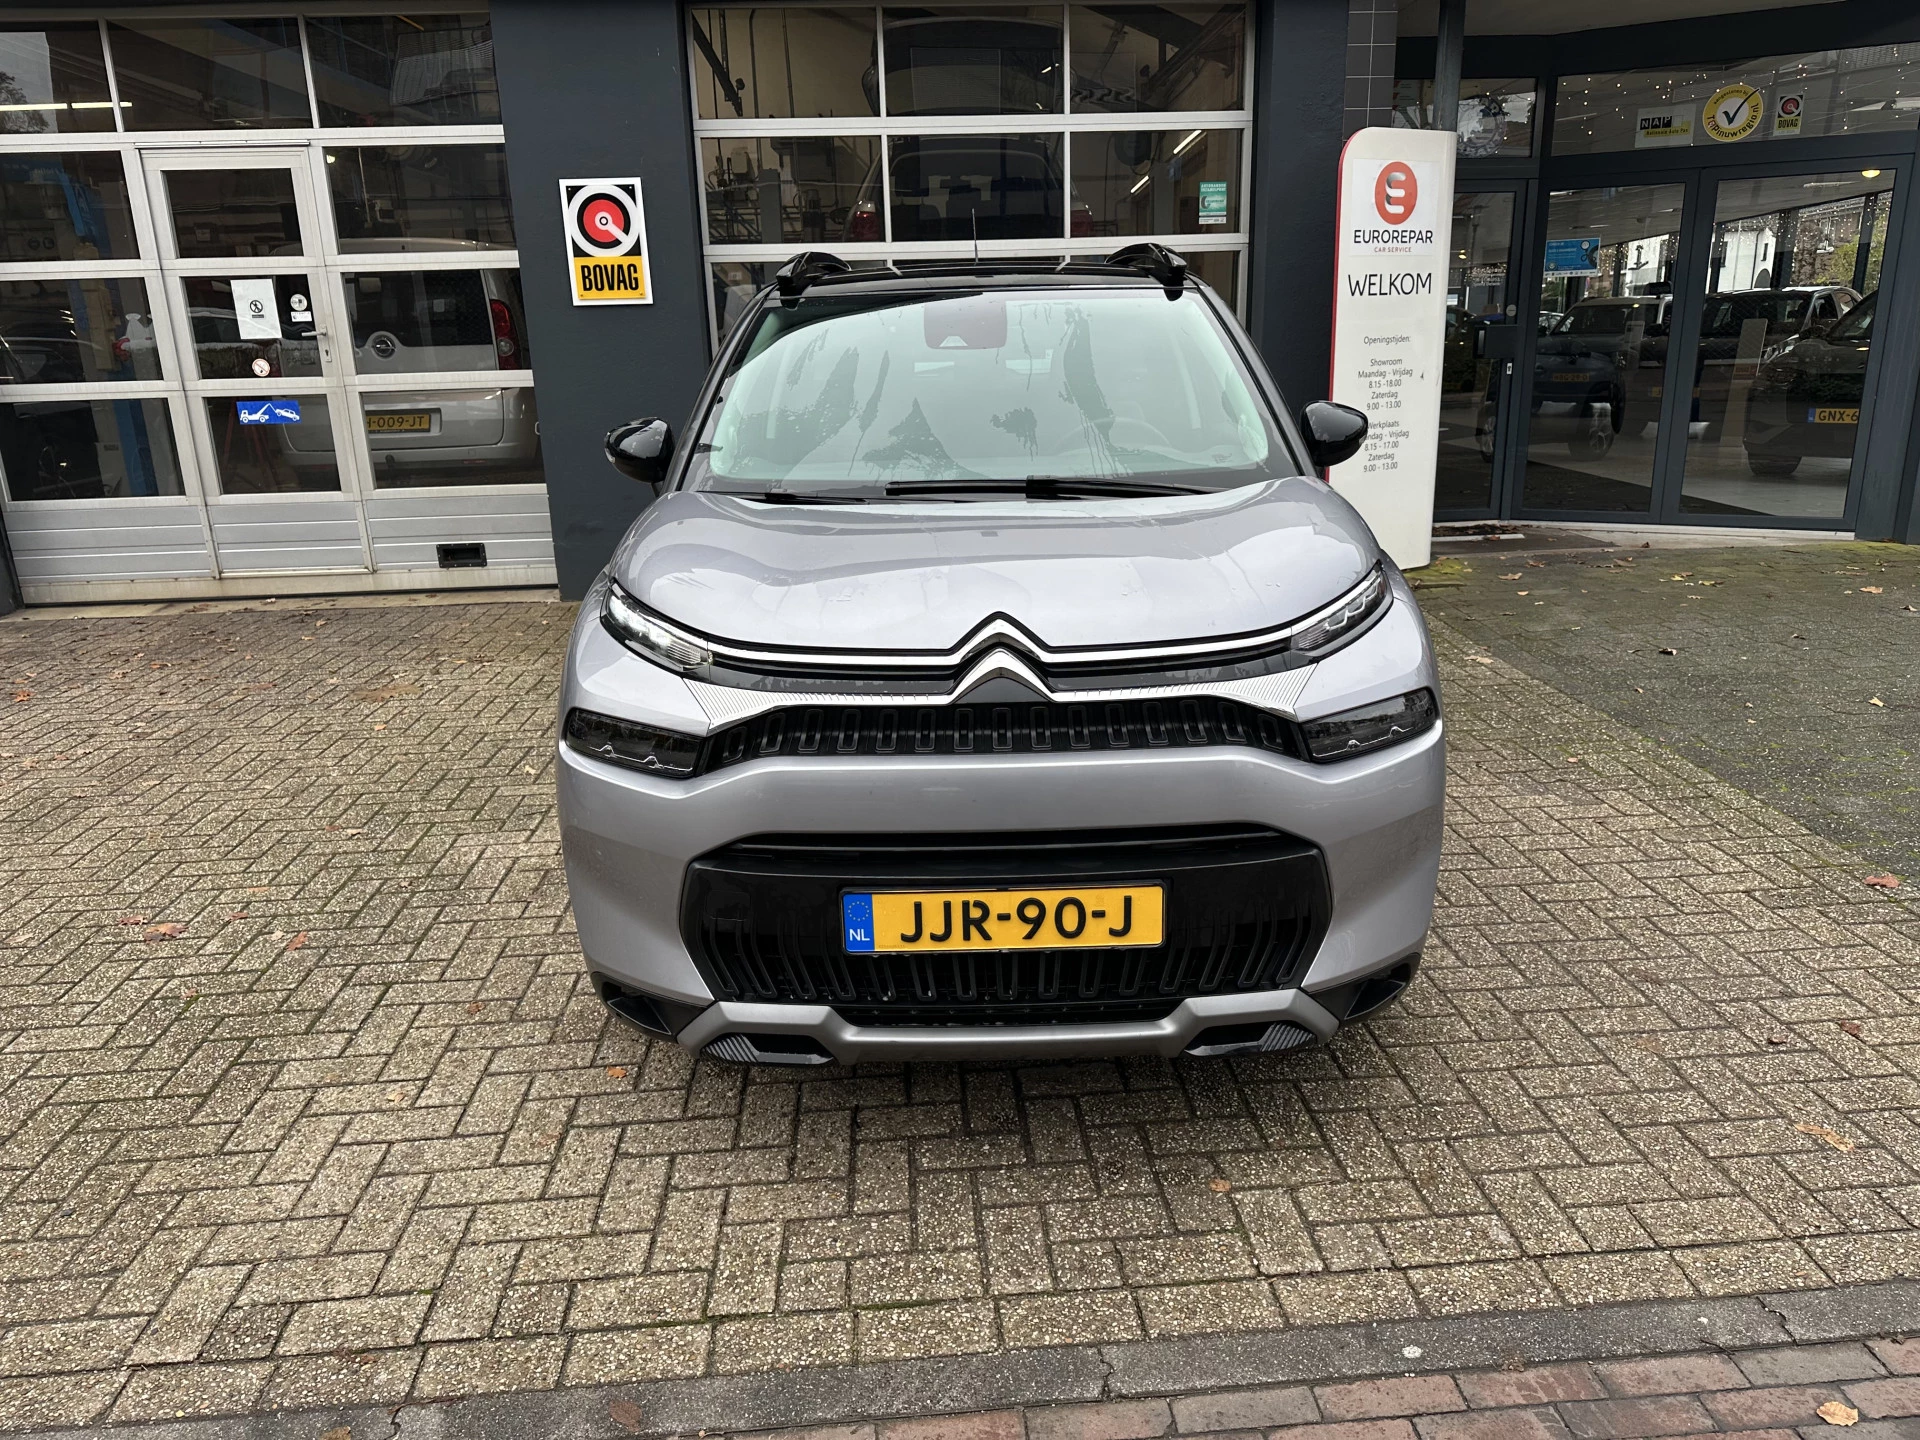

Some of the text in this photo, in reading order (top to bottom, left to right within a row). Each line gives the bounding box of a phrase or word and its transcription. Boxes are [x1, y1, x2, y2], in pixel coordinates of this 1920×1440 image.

[1641, 116, 1671, 129] NAP
[1777, 118, 1799, 129] BOVAG
[1353, 229, 1434, 244] EUROREPAR
[580, 263, 639, 291] BOVAG
[1347, 272, 1432, 296] WELKOM
[1370, 358, 1402, 367] Showroom
[1358, 369, 1387, 379] Maandag
[1392, 367, 1413, 377] Vrijdag
[1368, 380, 1381, 388] 8.15
[1371, 390, 1398, 399] Zaterdag
[1366, 401, 1380, 410] 9.00
[1385, 400, 1402, 409] 13.00
[1388, 430, 1410, 439] Vrijdag
[1364, 443, 1377, 451] 8.15
[1383, 441, 1399, 449] 17.00
[1368, 452, 1395, 461] Zaterdag
[1363, 464, 1376, 472] 9.00
[1382, 462, 1398, 470] 13.00
[849, 895, 1133, 942] NL JJR-90-J
